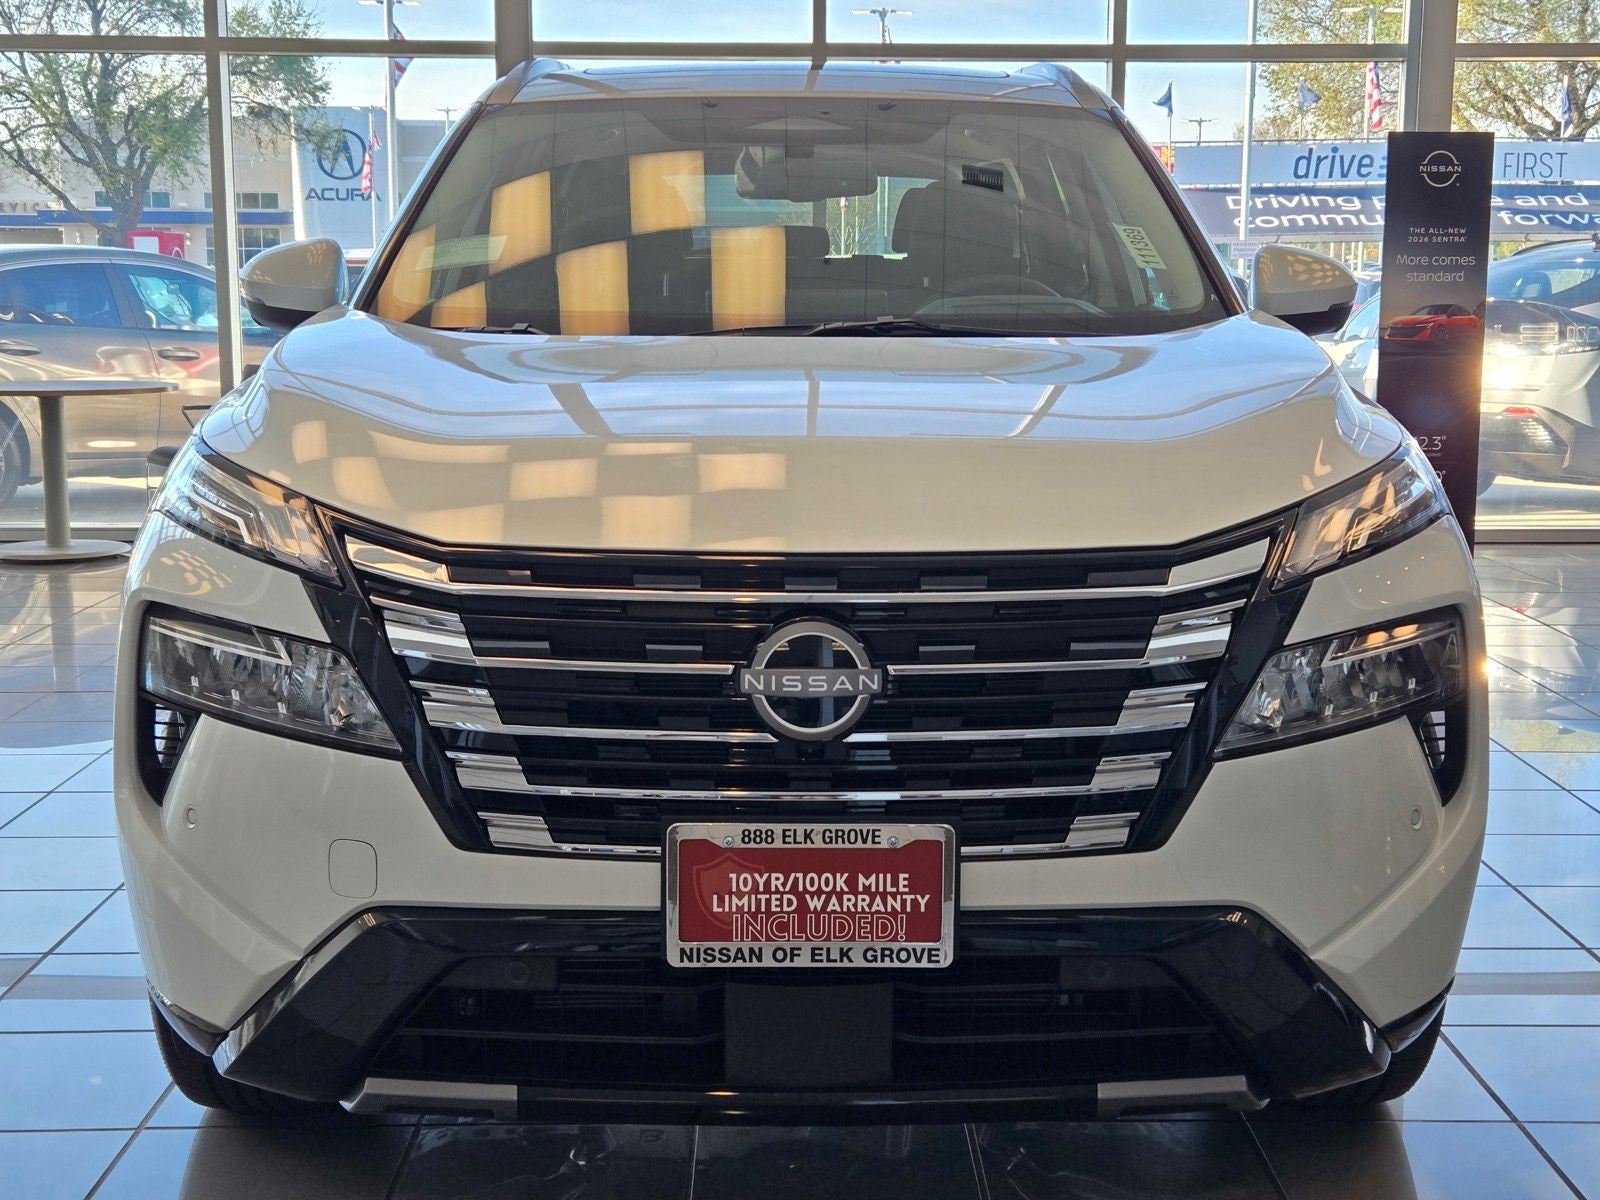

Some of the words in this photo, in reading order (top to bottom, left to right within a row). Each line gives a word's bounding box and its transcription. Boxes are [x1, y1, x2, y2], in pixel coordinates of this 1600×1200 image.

[1293, 146, 1375, 179] drive
[1503, 152, 1568, 178] FIRST
[305, 187, 381, 201] ACURA
[1225, 194, 1362, 211] Driving
[1514, 192, 1589, 206] and
[1233, 213, 1385, 228] commu
[1396, 254, 1429, 265] More
[1432, 256, 1476, 265] comes
[1406, 271, 1464, 282] standard
[744, 674, 878, 692] NISSAN
[741, 828, 775, 845] 888
[782, 829, 815, 845] ELK
[822, 829, 882, 845] GROVE
[729, 873, 849, 892] 10YR/100K
[858, 873, 910, 893] MILE
[712, 895, 798, 912] LIMITED
[805, 895, 931, 912] WARRANTY
[732, 914, 906, 941] INCLUDED!
[679, 947, 763, 963] NISSAN
[772, 947, 802, 963] OF
[810, 947, 854, 963] ELK
[862, 947, 941, 963] GROVE
